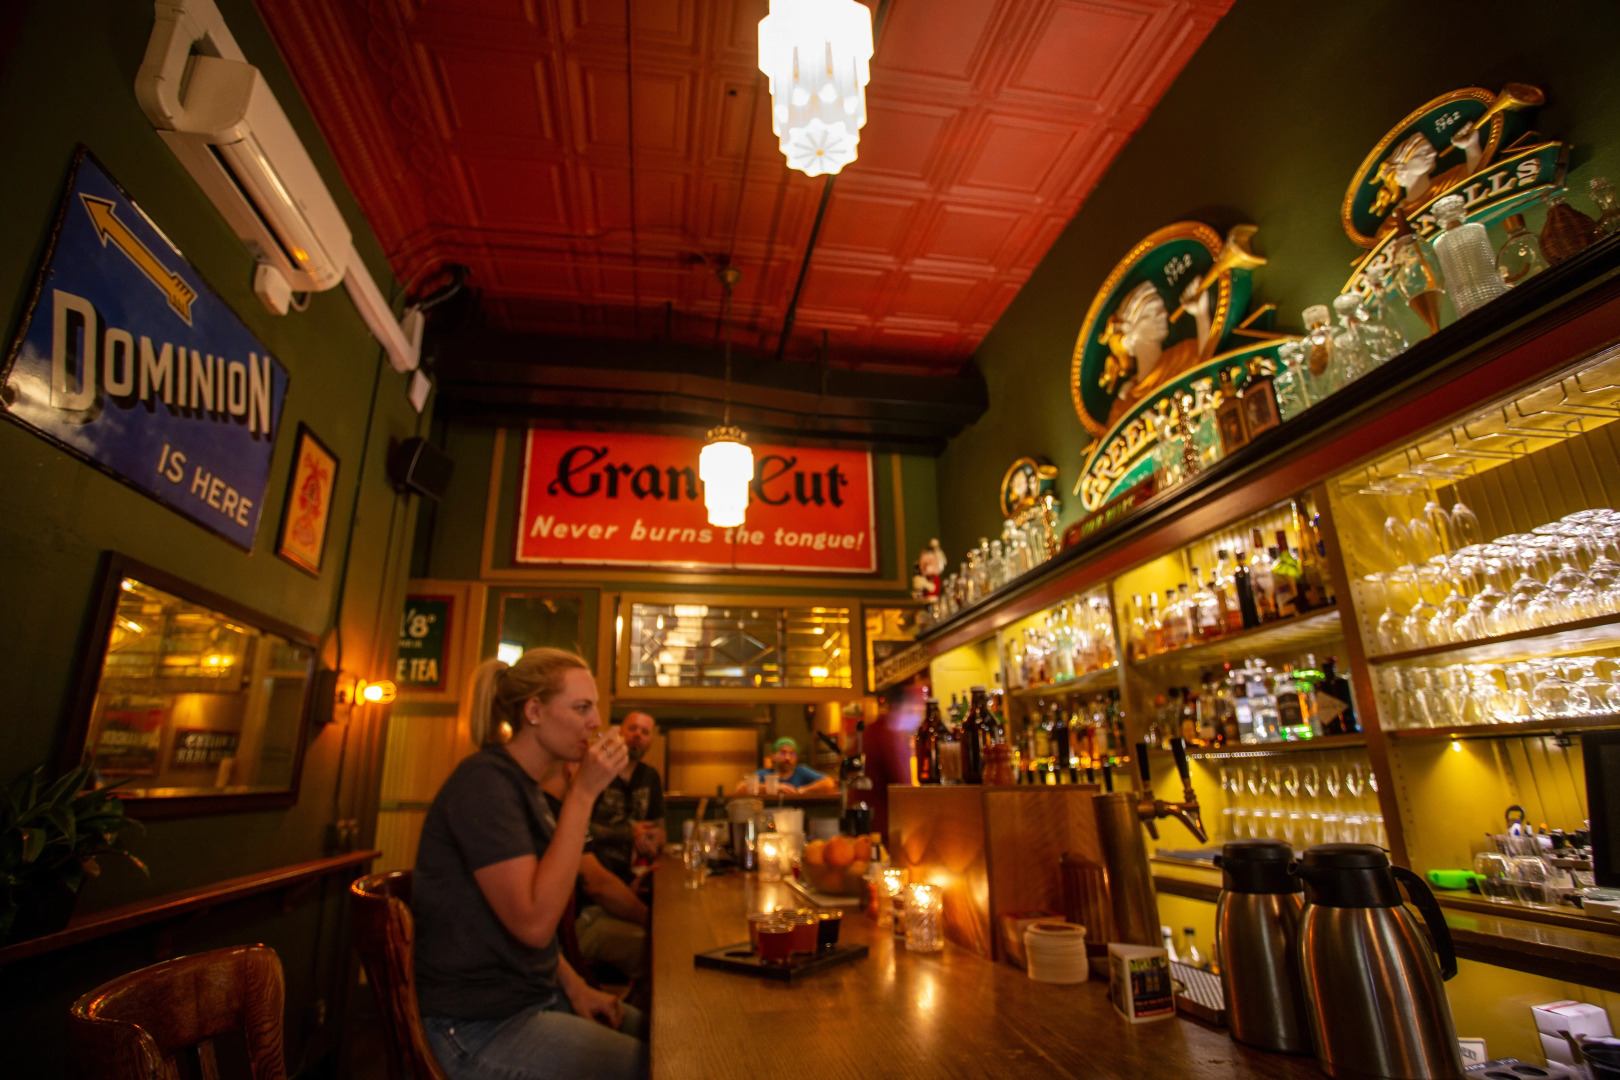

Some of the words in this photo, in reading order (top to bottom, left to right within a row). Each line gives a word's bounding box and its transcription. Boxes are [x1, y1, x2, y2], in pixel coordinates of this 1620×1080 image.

[1435, 110, 1461, 133] 1762
[51, 289, 272, 435] DOMINION
[157, 443, 187, 484] IS
[191, 466, 253, 528] HERE
[547, 446, 703, 501] Gran
[751, 455, 848, 508] Cut
[530, 514, 619, 540] Never
[630, 518, 713, 543] burns
[724, 525, 765, 545] the
[774, 527, 865, 551] tongue!
[410, 658, 438, 681] TEA
